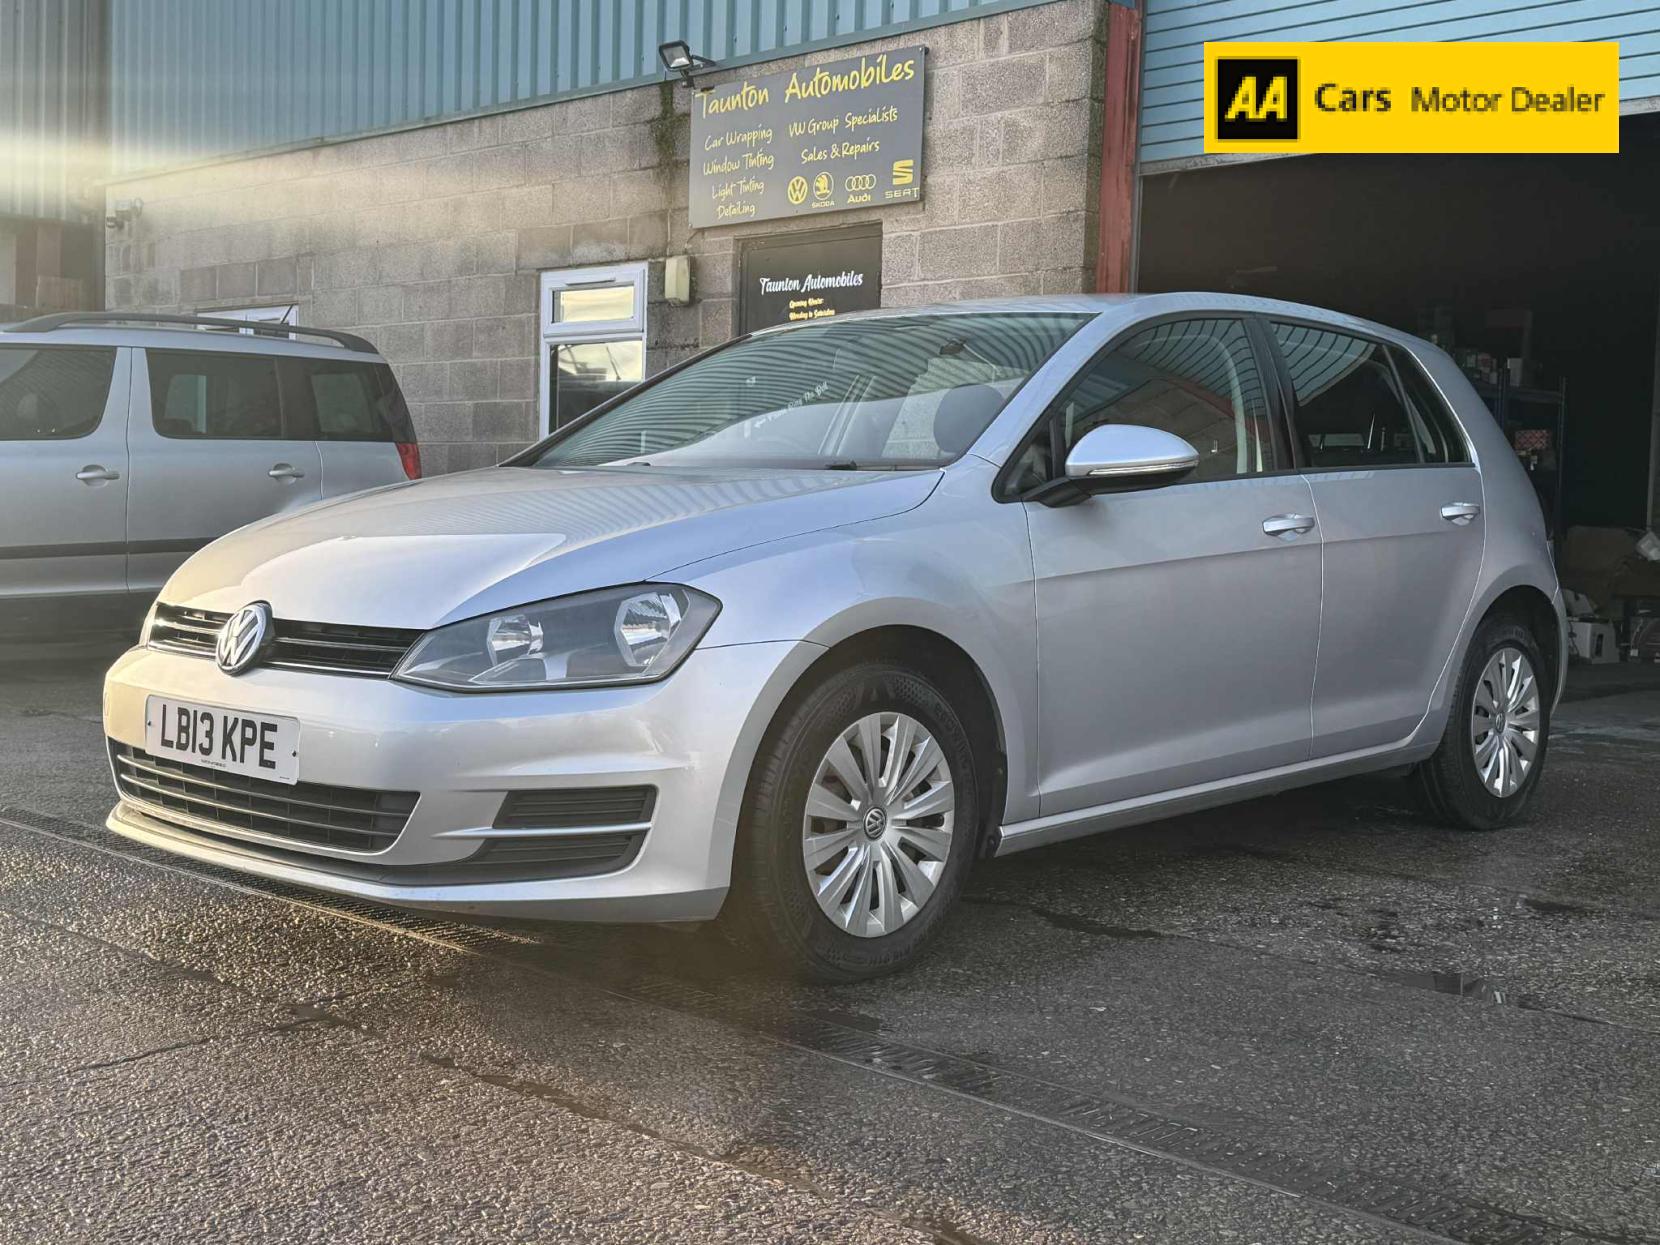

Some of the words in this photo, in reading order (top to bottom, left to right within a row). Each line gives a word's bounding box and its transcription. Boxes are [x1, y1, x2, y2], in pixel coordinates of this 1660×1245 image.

[696, 81, 769, 118] Taunton
[785, 54, 915, 103] Automobiles
[789, 120, 810, 137] VW
[808, 117, 839, 135] Group
[844, 106, 898, 131] Specialists
[704, 135, 724, 151] Car
[726, 123, 773, 148] Wrapping
[801, 147, 827, 165] Sales
[830, 145, 841, 158] &
[841, 137, 880, 161] Repairs
[703, 155, 740, 176] Window
[742, 147, 775, 170] Tinting
[711, 181, 736, 201] Light
[736, 175, 765, 195] Tinting
[847, 193, 871, 204] Audi
[885, 187, 920, 199] SEAT
[716, 201, 755, 219] Detailing
[759, 277, 800, 295] Taunton
[801, 270, 864, 293] Automobiles
[161, 704, 214, 757] LB13
[221, 715, 278, 769] KPE
